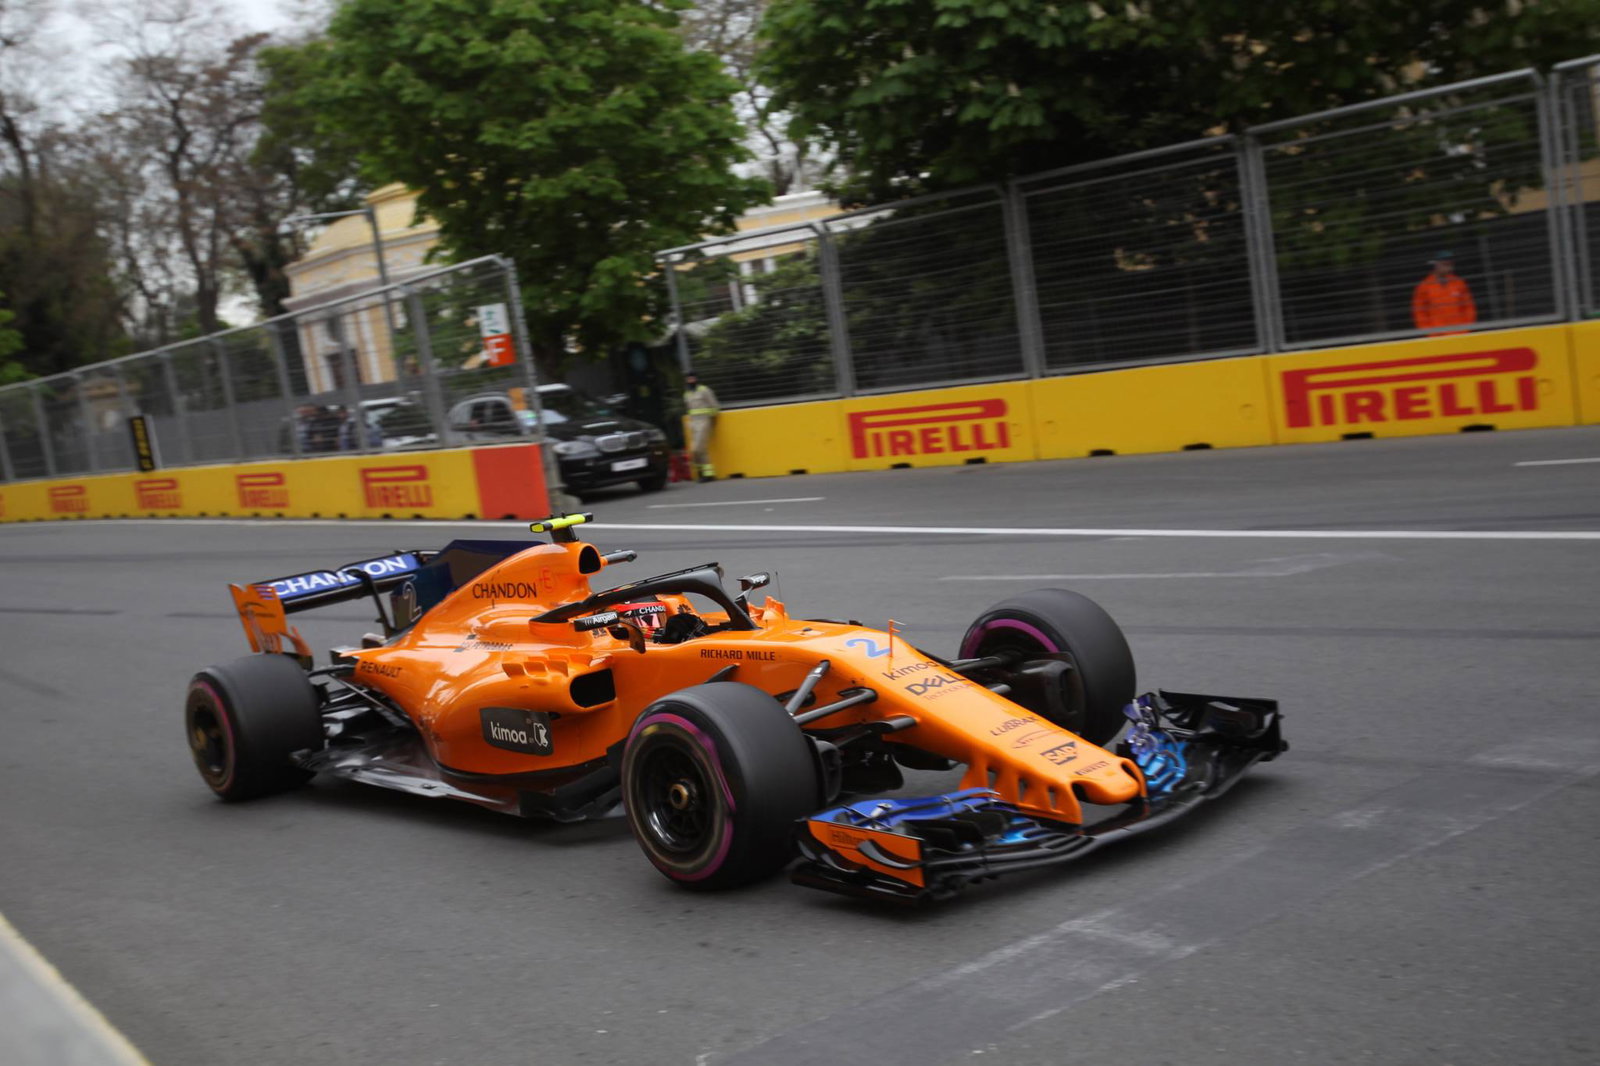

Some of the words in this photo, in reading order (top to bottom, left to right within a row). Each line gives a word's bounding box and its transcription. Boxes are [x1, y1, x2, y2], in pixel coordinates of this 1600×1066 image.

[1281, 347, 1538, 428] PIRELLI
[848, 398, 1010, 459] PIRELLI
[360, 465, 434, 508] PIRELLI
[472, 582, 537, 599] CHANDON
[700, 649, 743, 660] RICHARD
[746, 651, 775, 660] MILLE
[845, 638, 892, 658] 2
[360, 660, 402, 678] RENAULT
[904, 672, 967, 696] DELL
[490, 721, 528, 744] kimoa
